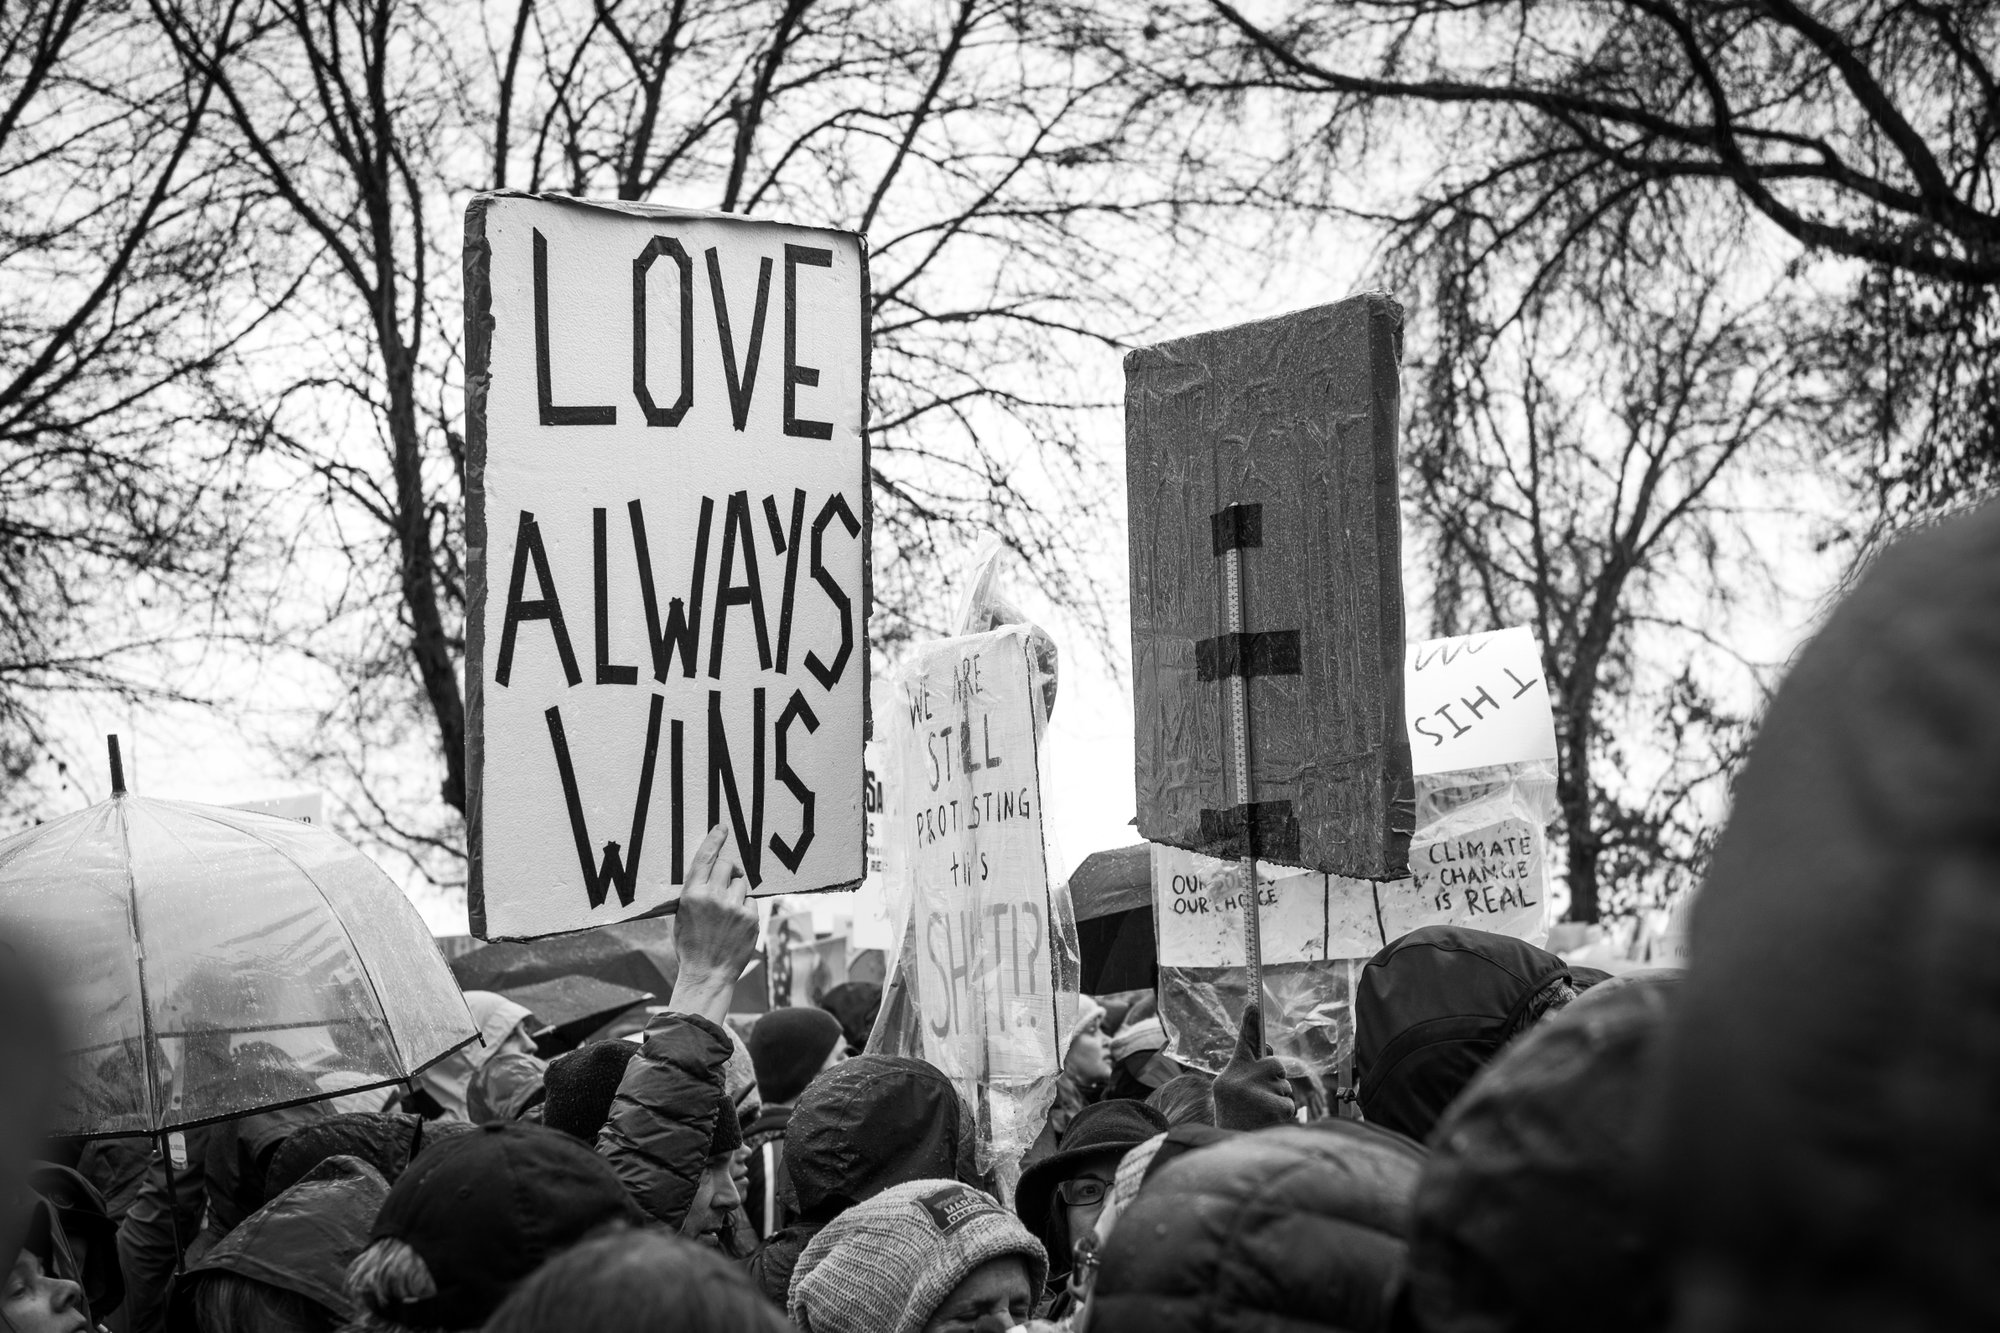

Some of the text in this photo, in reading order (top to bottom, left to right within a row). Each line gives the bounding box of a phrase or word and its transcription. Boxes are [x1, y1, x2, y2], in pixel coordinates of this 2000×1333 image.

[533, 227, 834, 441] LOVE
[495, 487, 862, 692] ALWAYS
[905, 654, 983, 730] WE ARE
[1415, 668, 1538, 746] THIS
[928, 714, 1002, 791] STLL
[544, 687, 821, 909] WINS
[1429, 837, 1531, 864] CLIMATE
[1441, 861, 1529, 886] CHANGE
[1174, 897, 1209, 915] OUR
[1435, 884, 1536, 915] IS REAL
